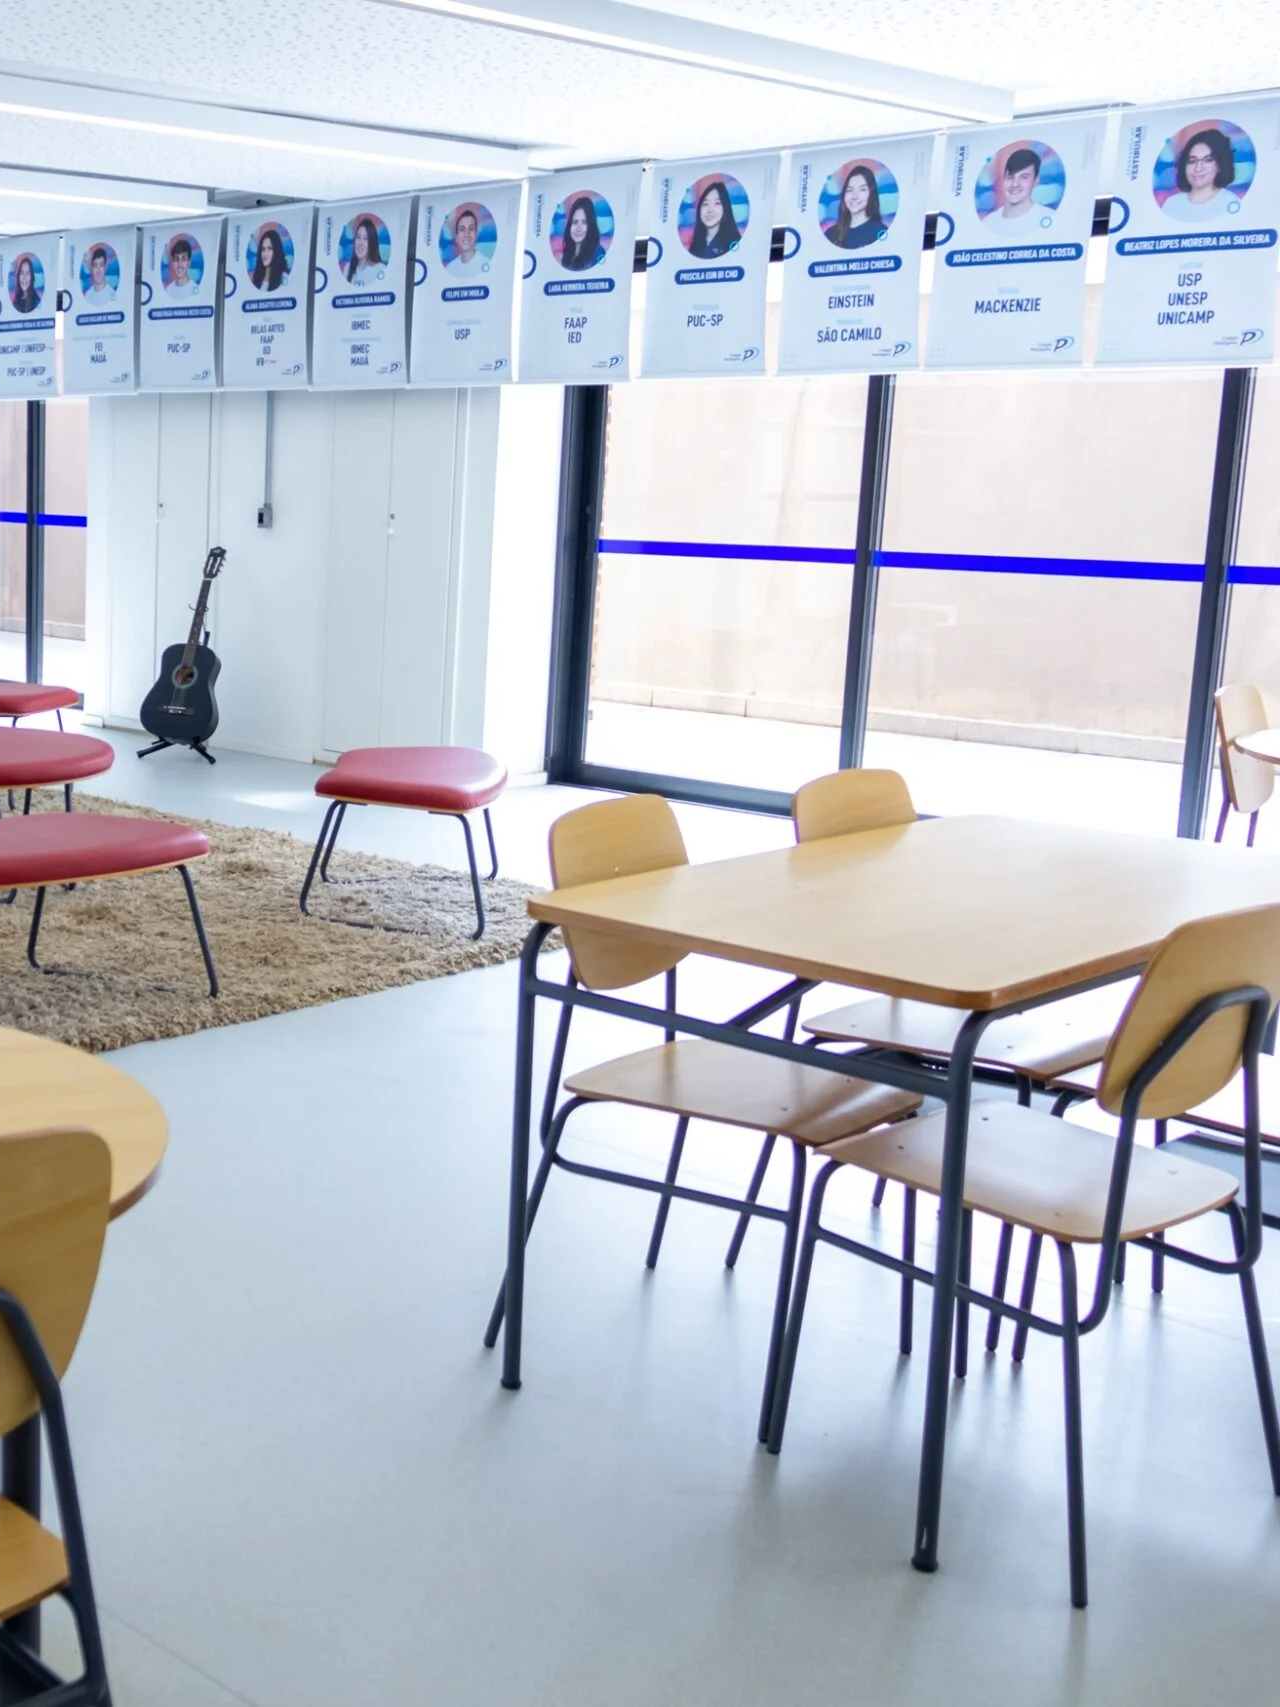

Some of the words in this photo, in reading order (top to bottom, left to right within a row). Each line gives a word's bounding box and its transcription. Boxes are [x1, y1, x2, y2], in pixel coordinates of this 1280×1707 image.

[1130, 126, 1142, 181] VESTIBULAR
[955, 145, 966, 197] VESTIBULAR
[1124, 240, 1155, 252] BEATRIZ
[1155, 239, 1180, 250] LOPES
[1180, 236, 1218, 248] MOREIRA
[1219, 236, 1232, 246] DA
[1233, 233, 1270, 245] SILVEIRA
[952, 250, 970, 263] JOÃO
[971, 250, 1008, 262] CELESTINO
[1008, 249, 1038, 260] CORREA
[1038, 248, 1050, 258] DA
[1051, 247, 1076, 258] COSTA
[814, 263, 848, 274] VALENTINA
[848, 261, 869, 271] MELLO
[870, 259, 895, 270] CHIESA
[680, 271, 705, 281] PRISCILA
[725, 269, 738, 279] CHO
[1177, 272, 1202, 287] USP
[445, 289, 460, 299] FELIPE
[828, 293, 875, 309] EINSTEIN
[1168, 291, 1208, 306] UNESP
[974, 297, 1042, 314] MACKENZIE
[564, 316, 587, 329] FAAP
[687, 313, 723, 327] PUC-SP
[1157, 310, 1215, 325] UNICAMP
[250, 325, 267, 334] BELAS
[268, 323, 285, 333] ARTES
[454, 328, 470, 340] USP
[817, 326, 838, 343] SÃO
[841, 326, 882, 342] CAMILO
[260, 335, 274, 345] FAAP
[567, 331, 582, 343] IED
[167, 343, 191, 353] PUC-SP
